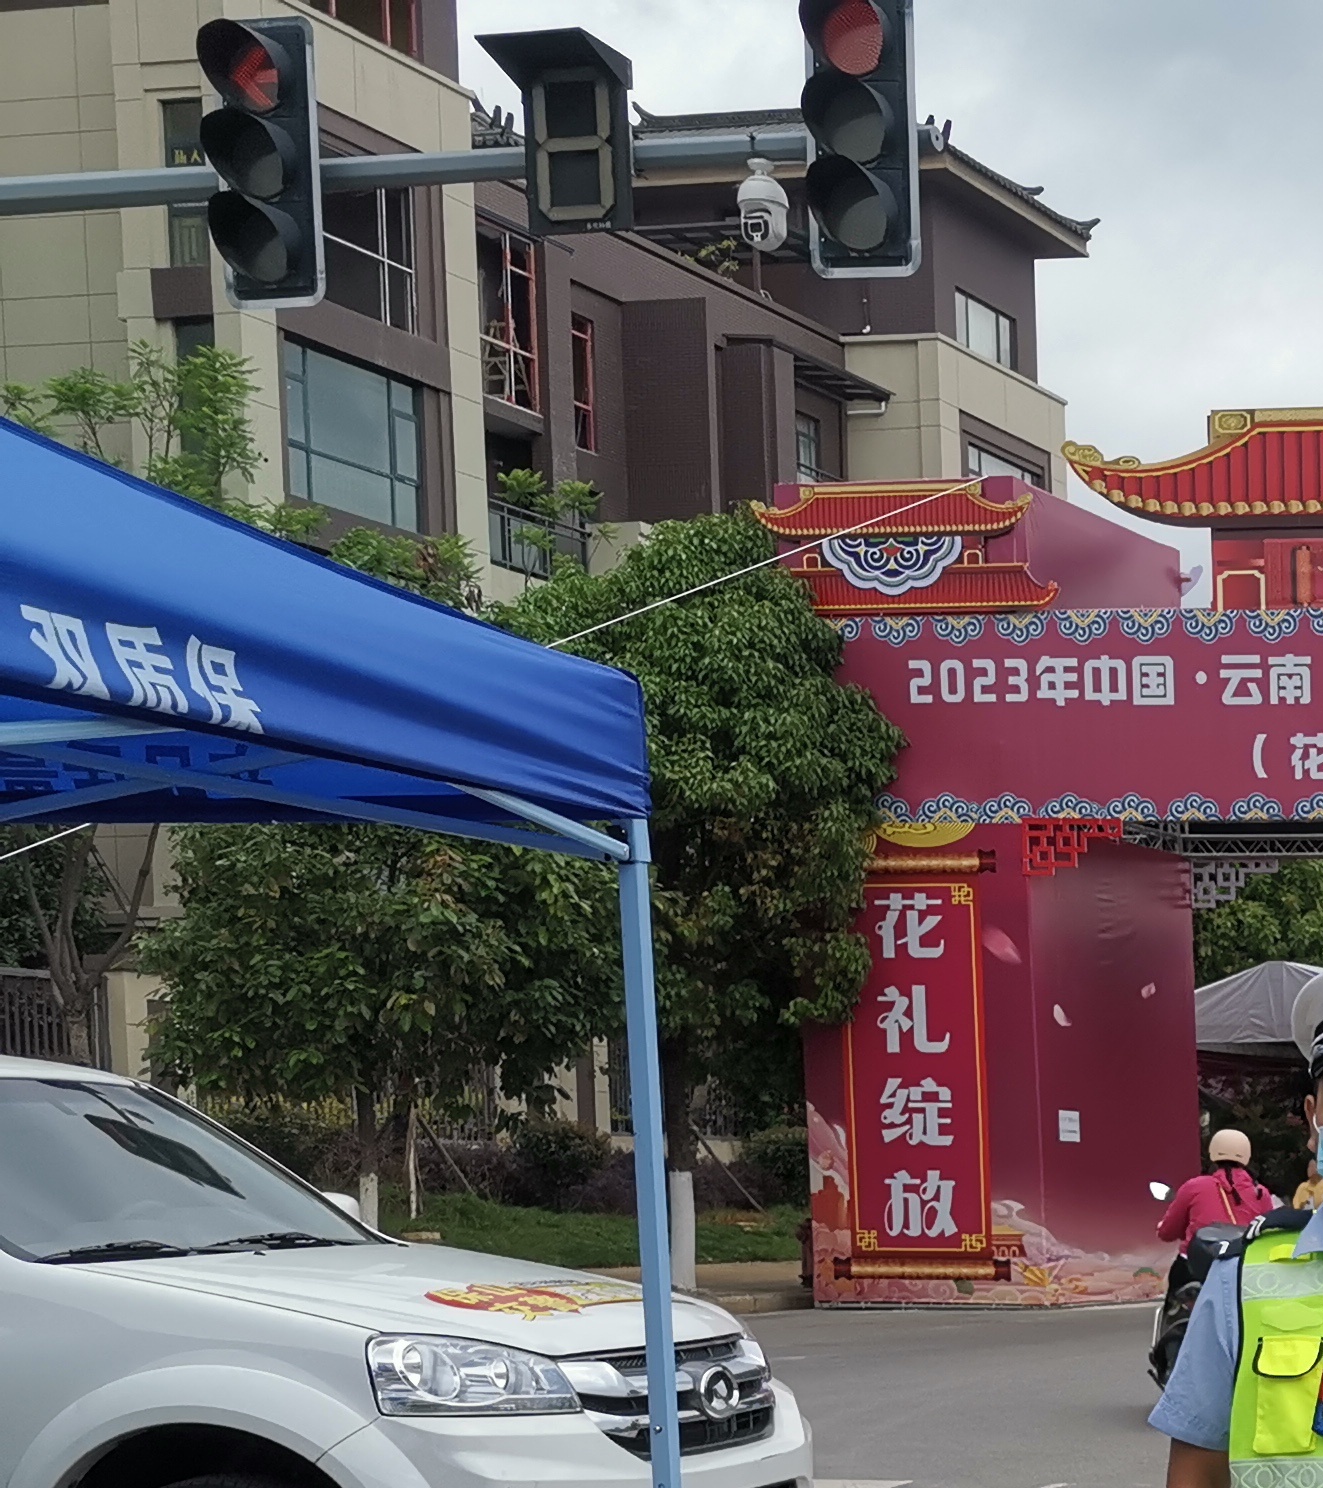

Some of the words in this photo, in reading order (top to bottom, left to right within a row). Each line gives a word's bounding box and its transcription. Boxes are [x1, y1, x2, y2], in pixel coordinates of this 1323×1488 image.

[20, 604, 264, 734] 双质保
[874, 892, 958, 1238] 花礼绽放
